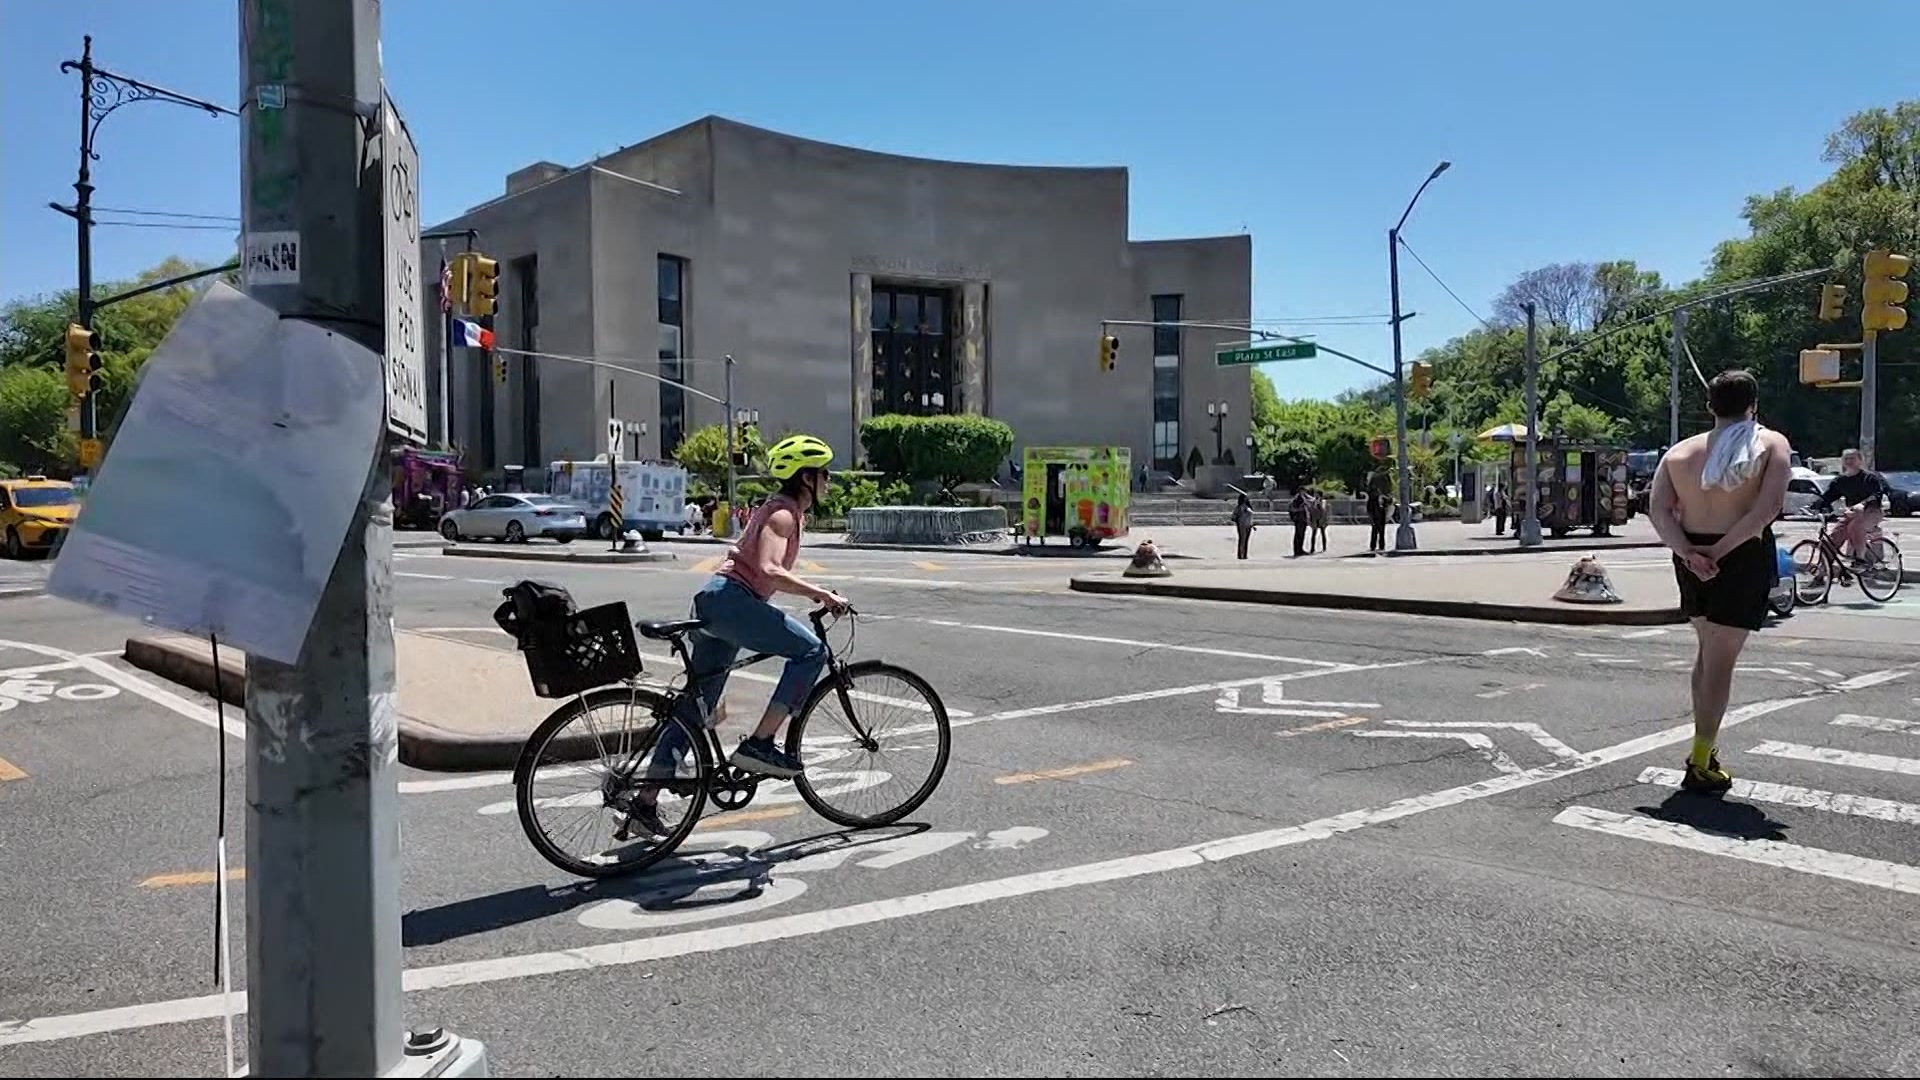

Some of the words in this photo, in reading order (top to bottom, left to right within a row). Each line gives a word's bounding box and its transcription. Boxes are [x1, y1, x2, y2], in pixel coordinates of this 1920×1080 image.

[397, 250, 414, 302] USE
[398, 304, 416, 353] PED
[1234, 352, 1260, 361] Plaza
[1263, 350, 1273, 360] St
[1275, 348, 1298, 358] East
[392, 355, 423, 410] SIGNAL
